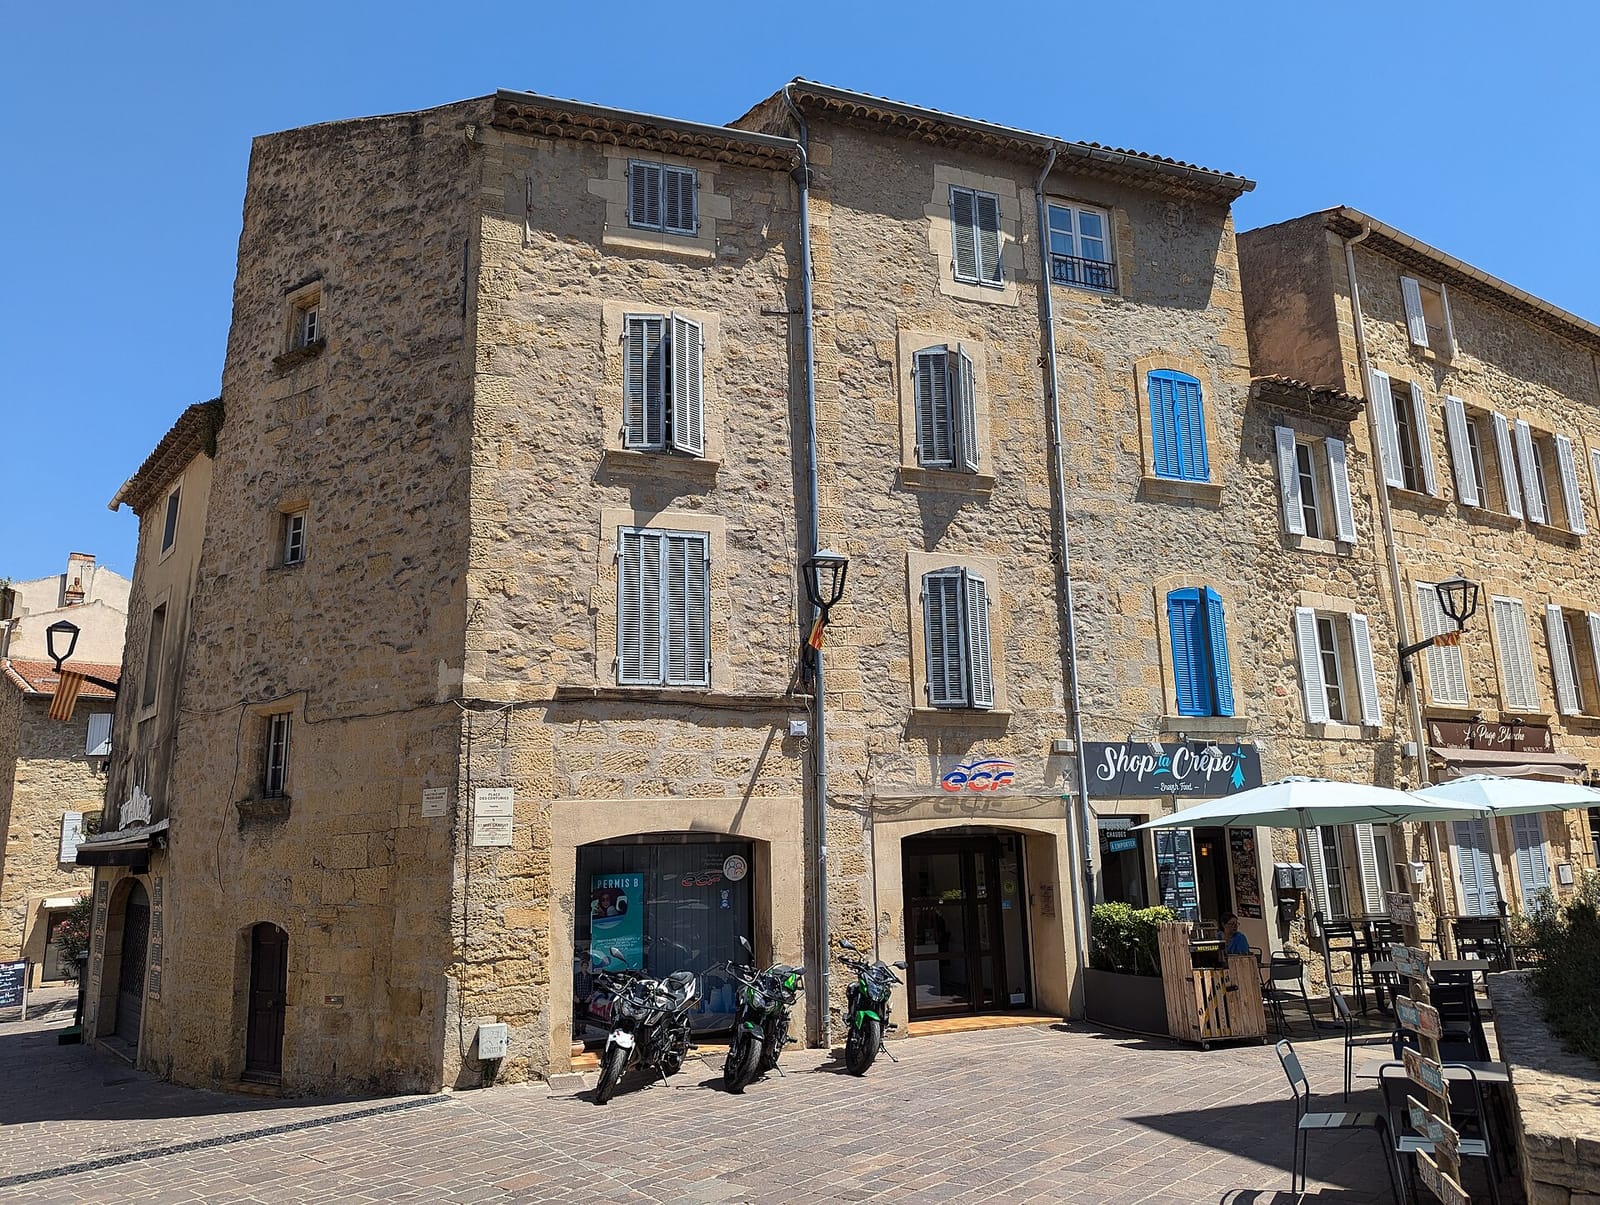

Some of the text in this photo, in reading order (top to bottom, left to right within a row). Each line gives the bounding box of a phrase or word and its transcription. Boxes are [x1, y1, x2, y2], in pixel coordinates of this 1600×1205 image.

[1476, 724, 1496, 746] Page
[1096, 745, 1157, 782] Shop
[597, 878, 639, 889] PERMIS B
